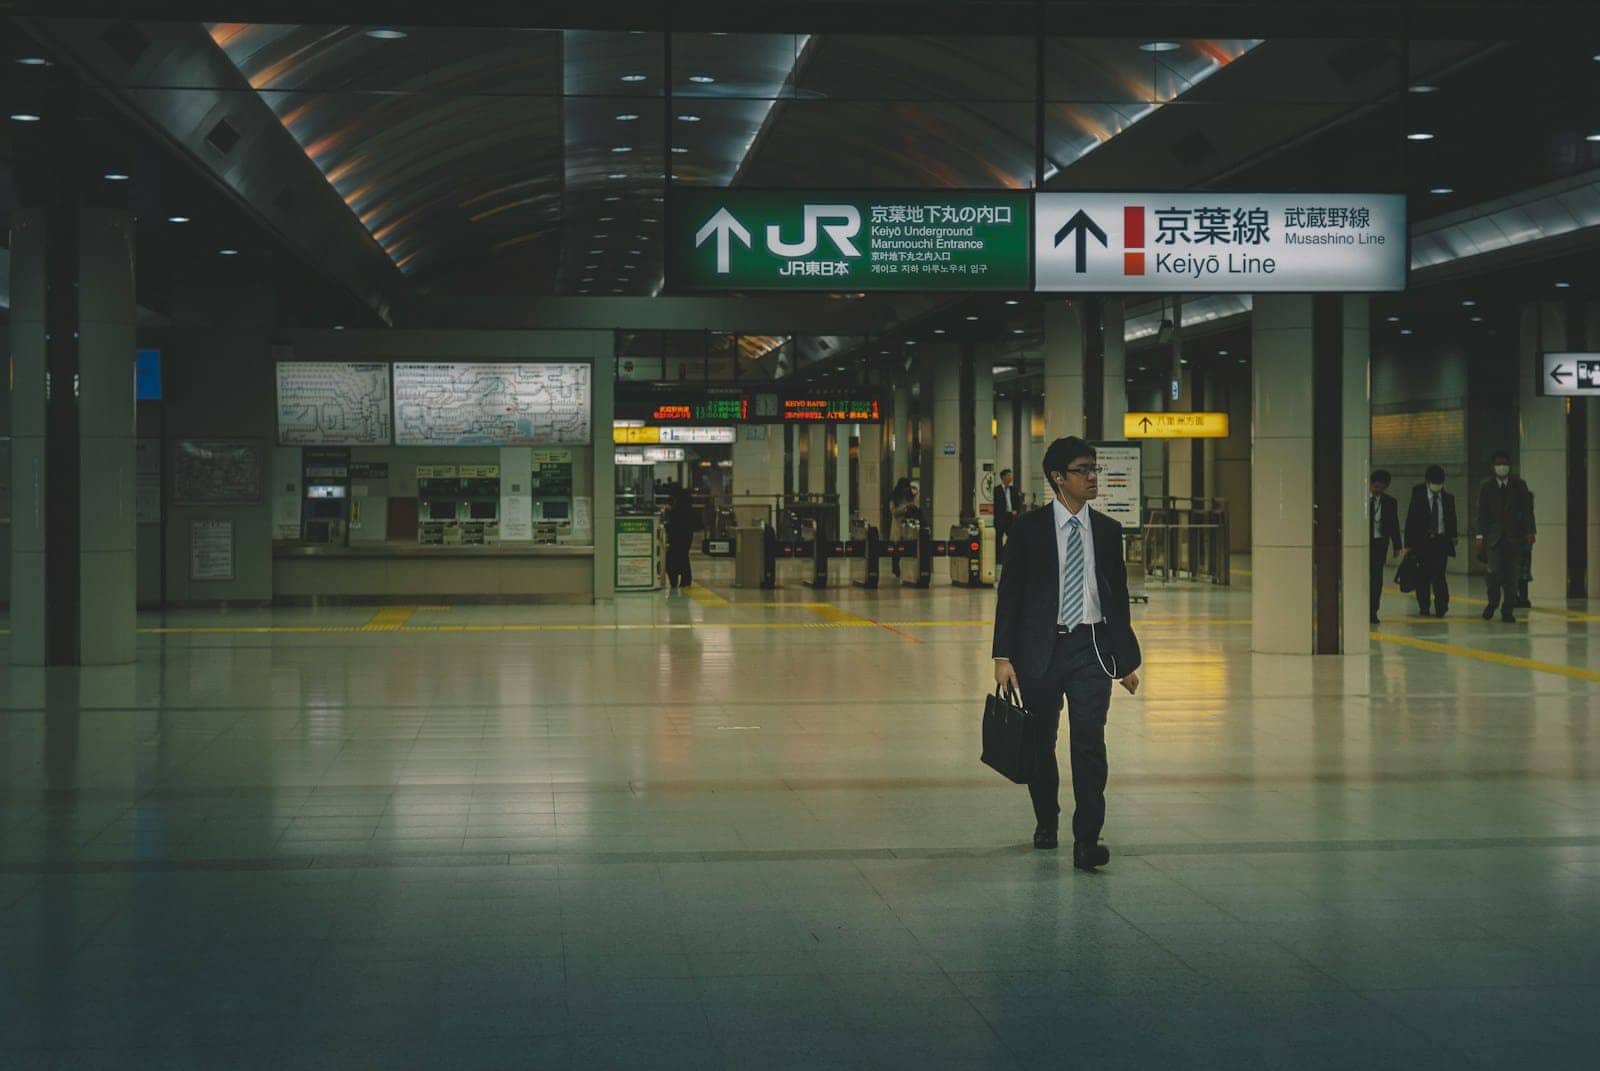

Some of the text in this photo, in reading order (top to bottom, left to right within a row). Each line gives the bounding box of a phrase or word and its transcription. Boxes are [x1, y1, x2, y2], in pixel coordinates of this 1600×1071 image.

[870, 206, 1012, 223] 京葉地下丸の内口
[1284, 207, 1370, 228] 武蔵野線
[767, 205, 861, 256] JR
[872, 226, 973, 238] Keiyō Underground
[1154, 206, 1270, 245] 京葉線
[871, 239, 984, 249] Marunouchi Entrance
[1285, 232, 1385, 245] Musashino Line
[780, 261, 849, 276] JR東日本
[1156, 253, 1276, 279] Keiyō Line
